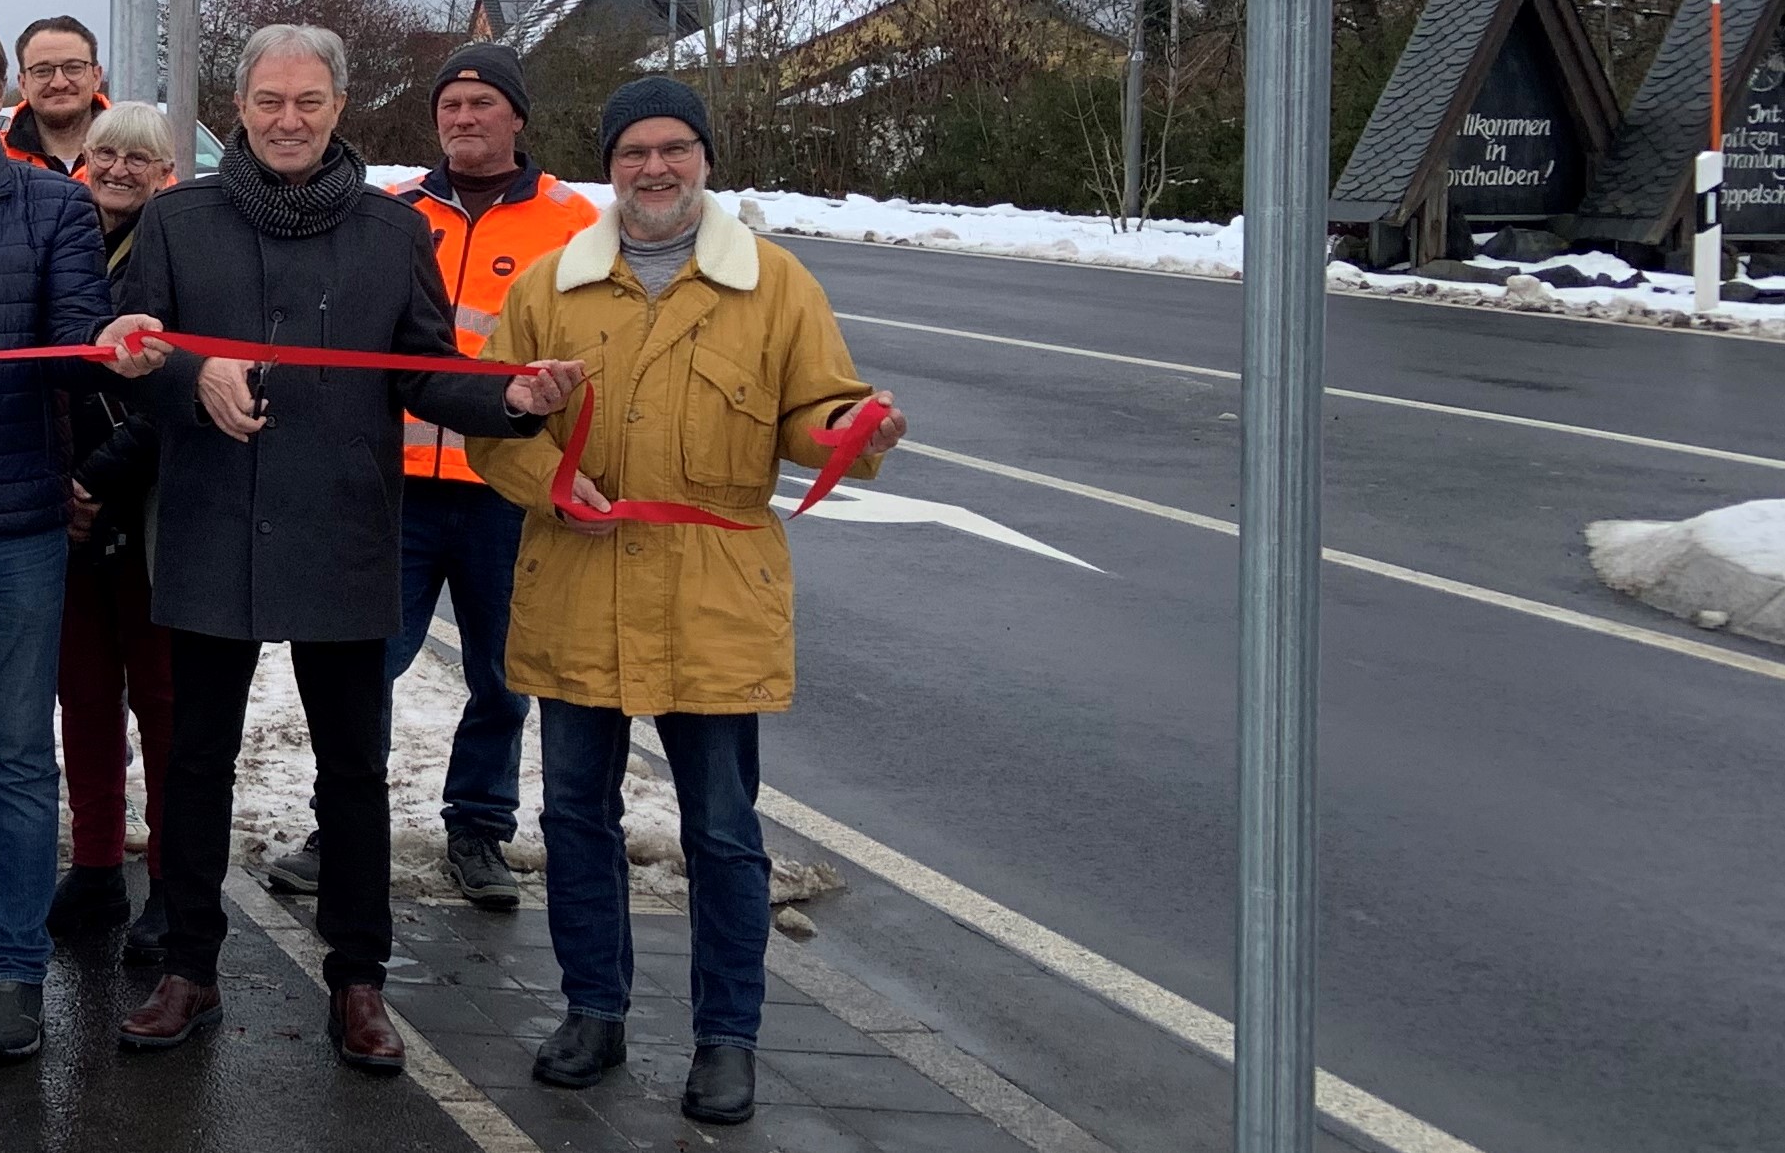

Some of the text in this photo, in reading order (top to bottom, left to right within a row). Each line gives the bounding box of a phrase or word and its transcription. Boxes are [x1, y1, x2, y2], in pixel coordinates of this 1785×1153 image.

[1457, 113, 1551, 139] llkommen
[1485, 138, 1506, 161] in
[1447, 160, 1555, 186] ordhalben!
